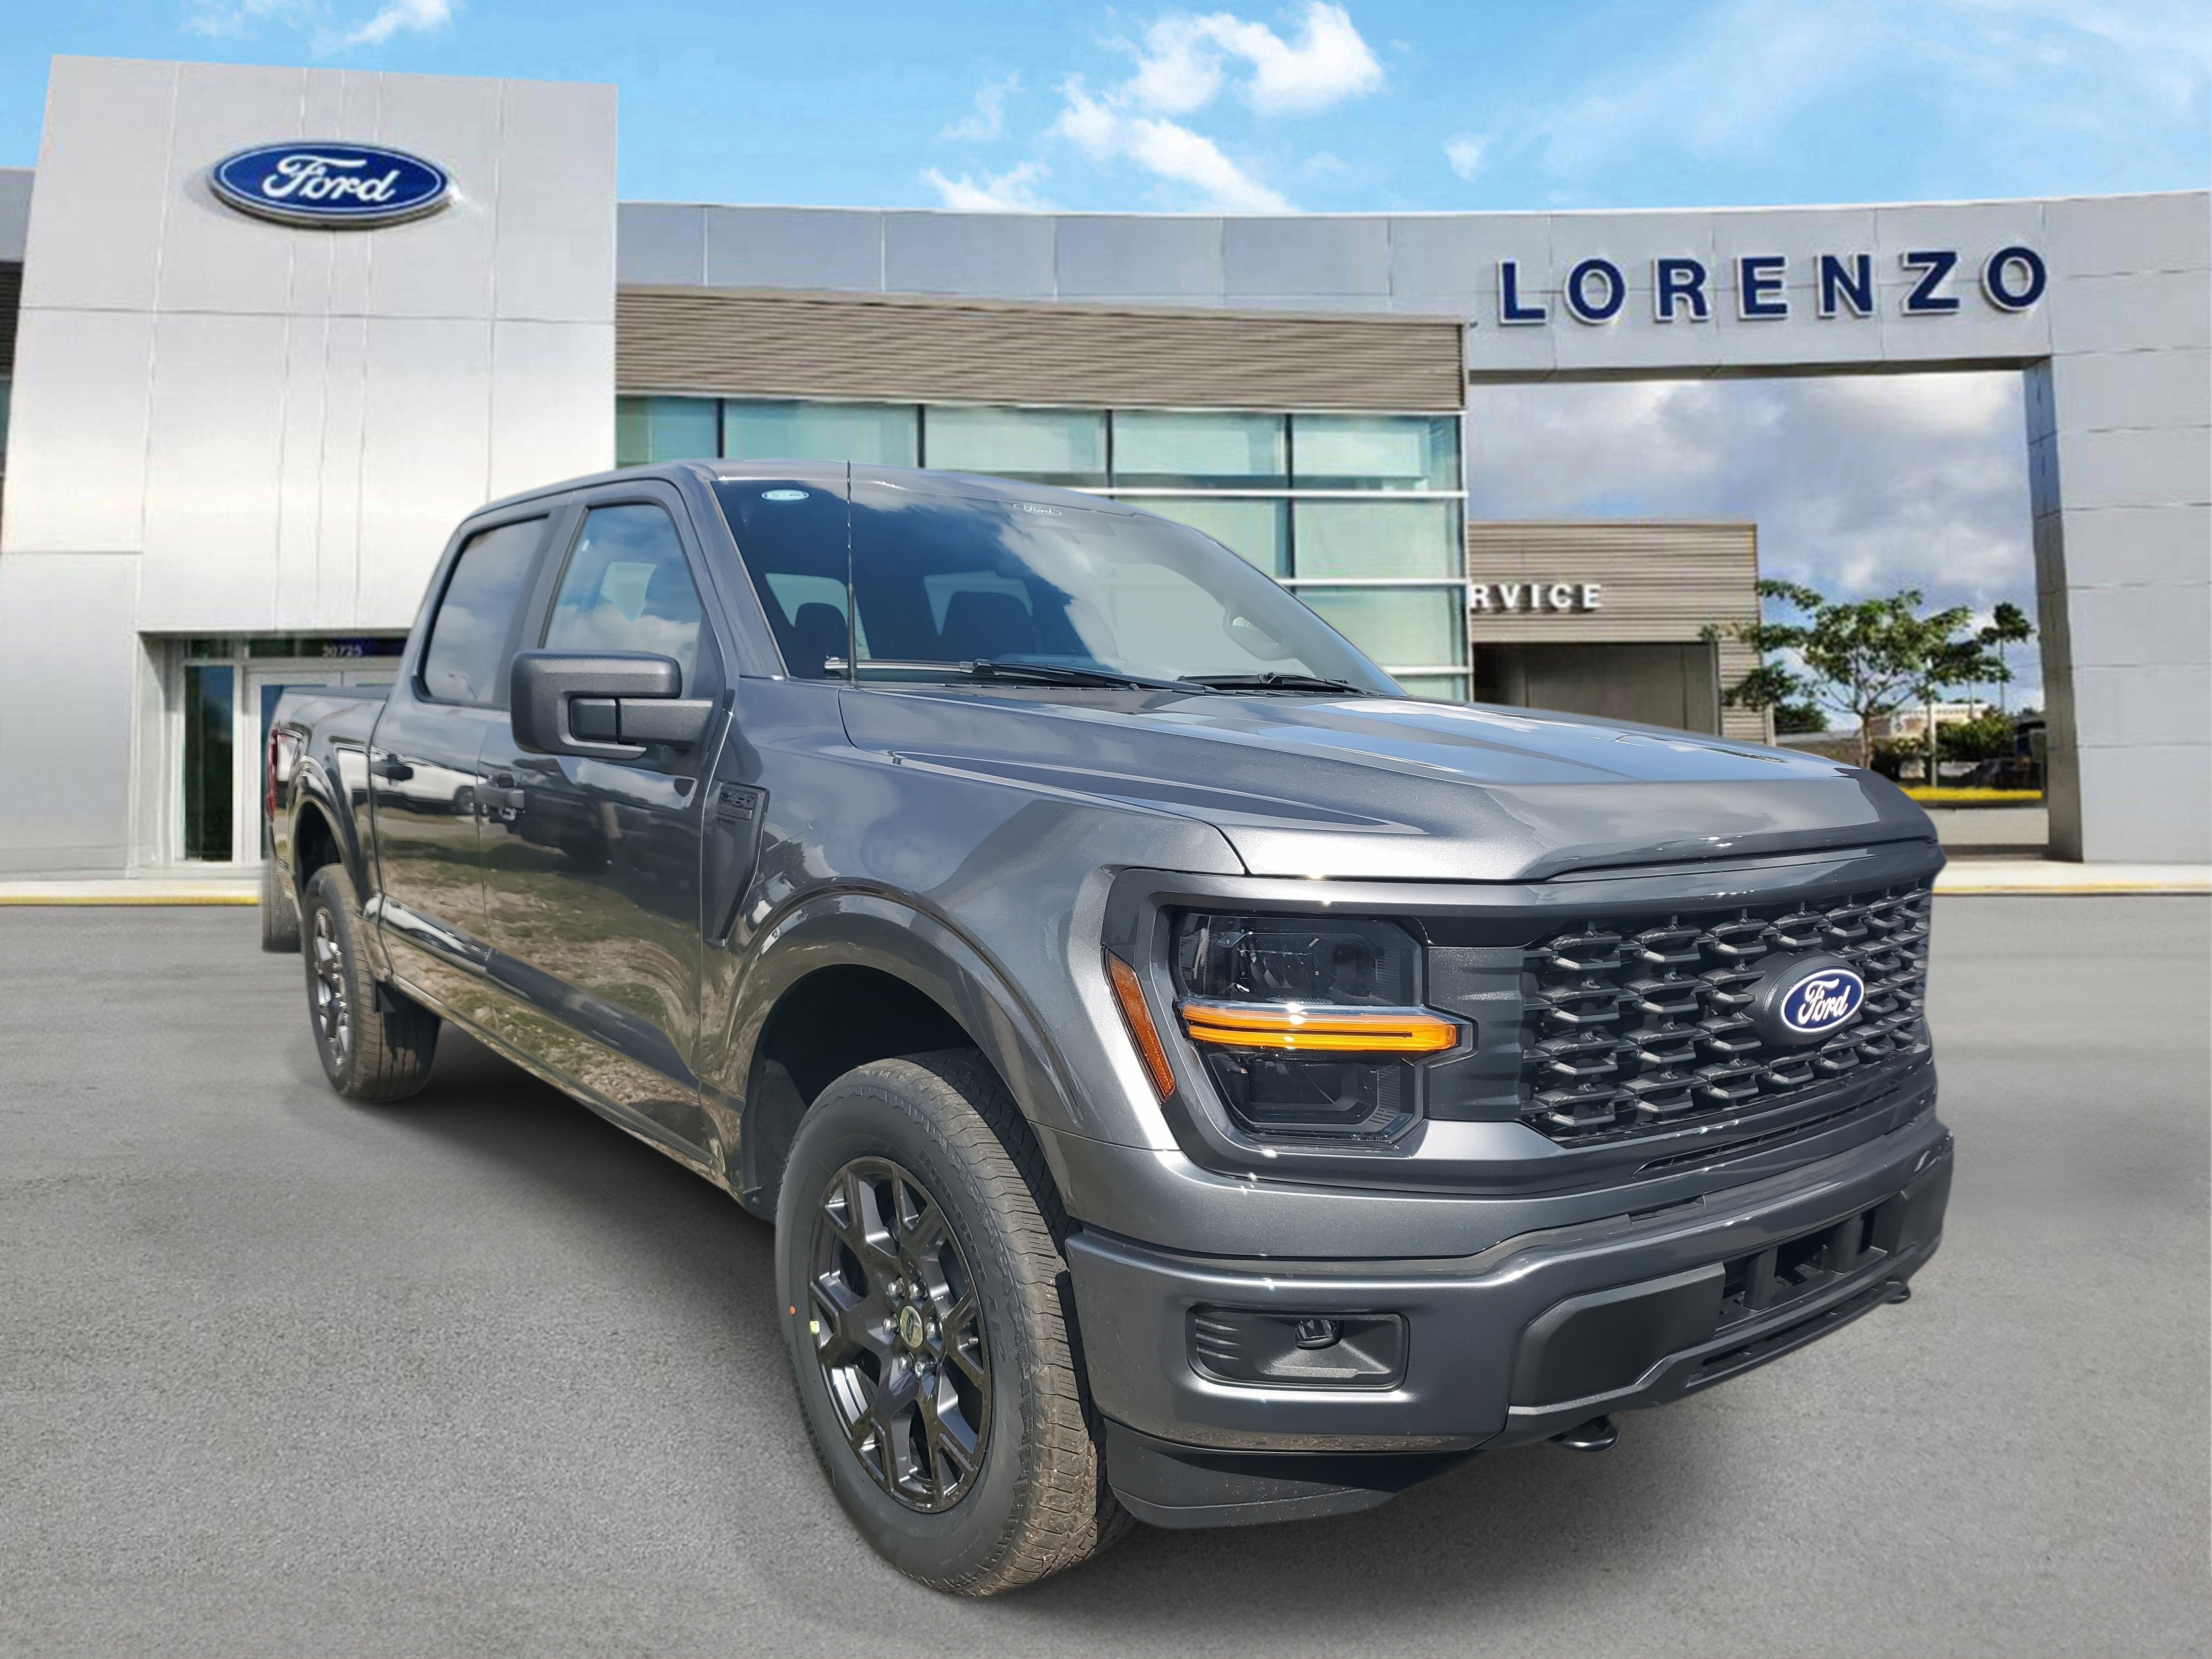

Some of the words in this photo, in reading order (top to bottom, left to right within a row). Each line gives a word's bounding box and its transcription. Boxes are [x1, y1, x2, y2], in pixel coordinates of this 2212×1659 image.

[263, 154, 400, 202] Ford
[1496, 246, 2047, 325] LORENZO
[1470, 583, 1603, 609] RVICE
[1798, 978, 1851, 1025] Ford
